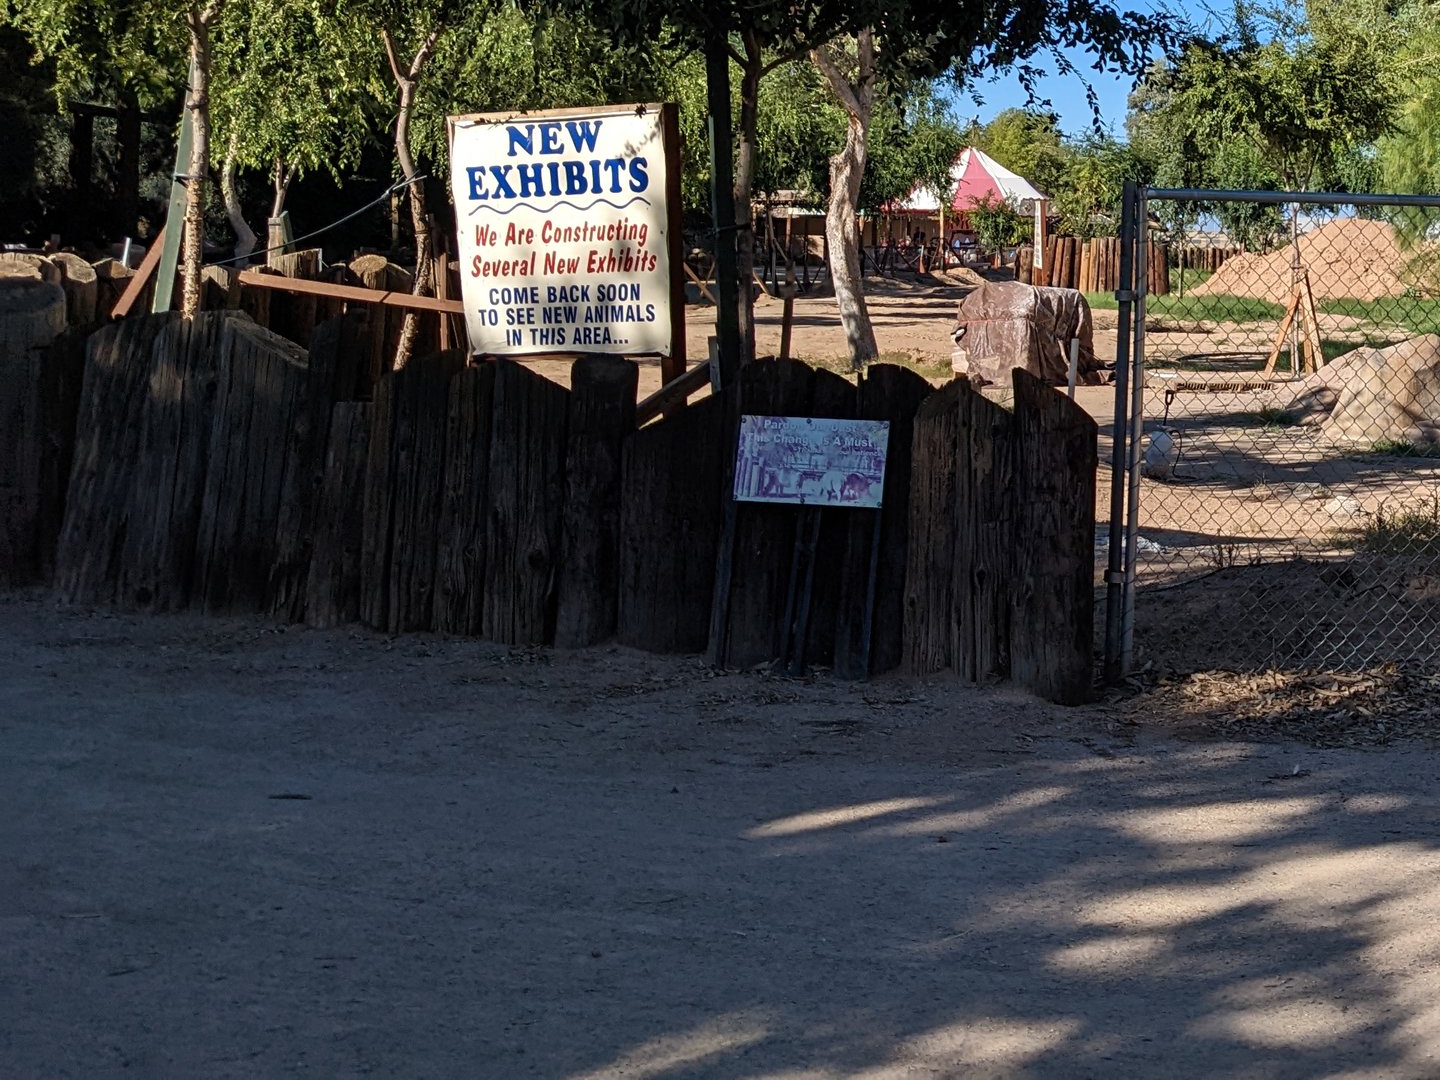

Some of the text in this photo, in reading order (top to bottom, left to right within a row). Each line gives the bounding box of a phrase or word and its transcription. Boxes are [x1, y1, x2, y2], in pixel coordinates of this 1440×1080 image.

[506, 120, 603, 157] NEW
[466, 157, 649, 200] EXHIBITS
[475, 217, 648, 247] We Are Constructing
[471, 247, 657, 278] Several New Exhibits
[489, 283, 640, 305] COME BACK SOON
[478, 304, 655, 326] TO SEE NEW ANIMALS
[506, 326, 629, 346] IN THIS AREA...
[773, 433, 813, 446] Chang
[833, 436, 841, 446] A
